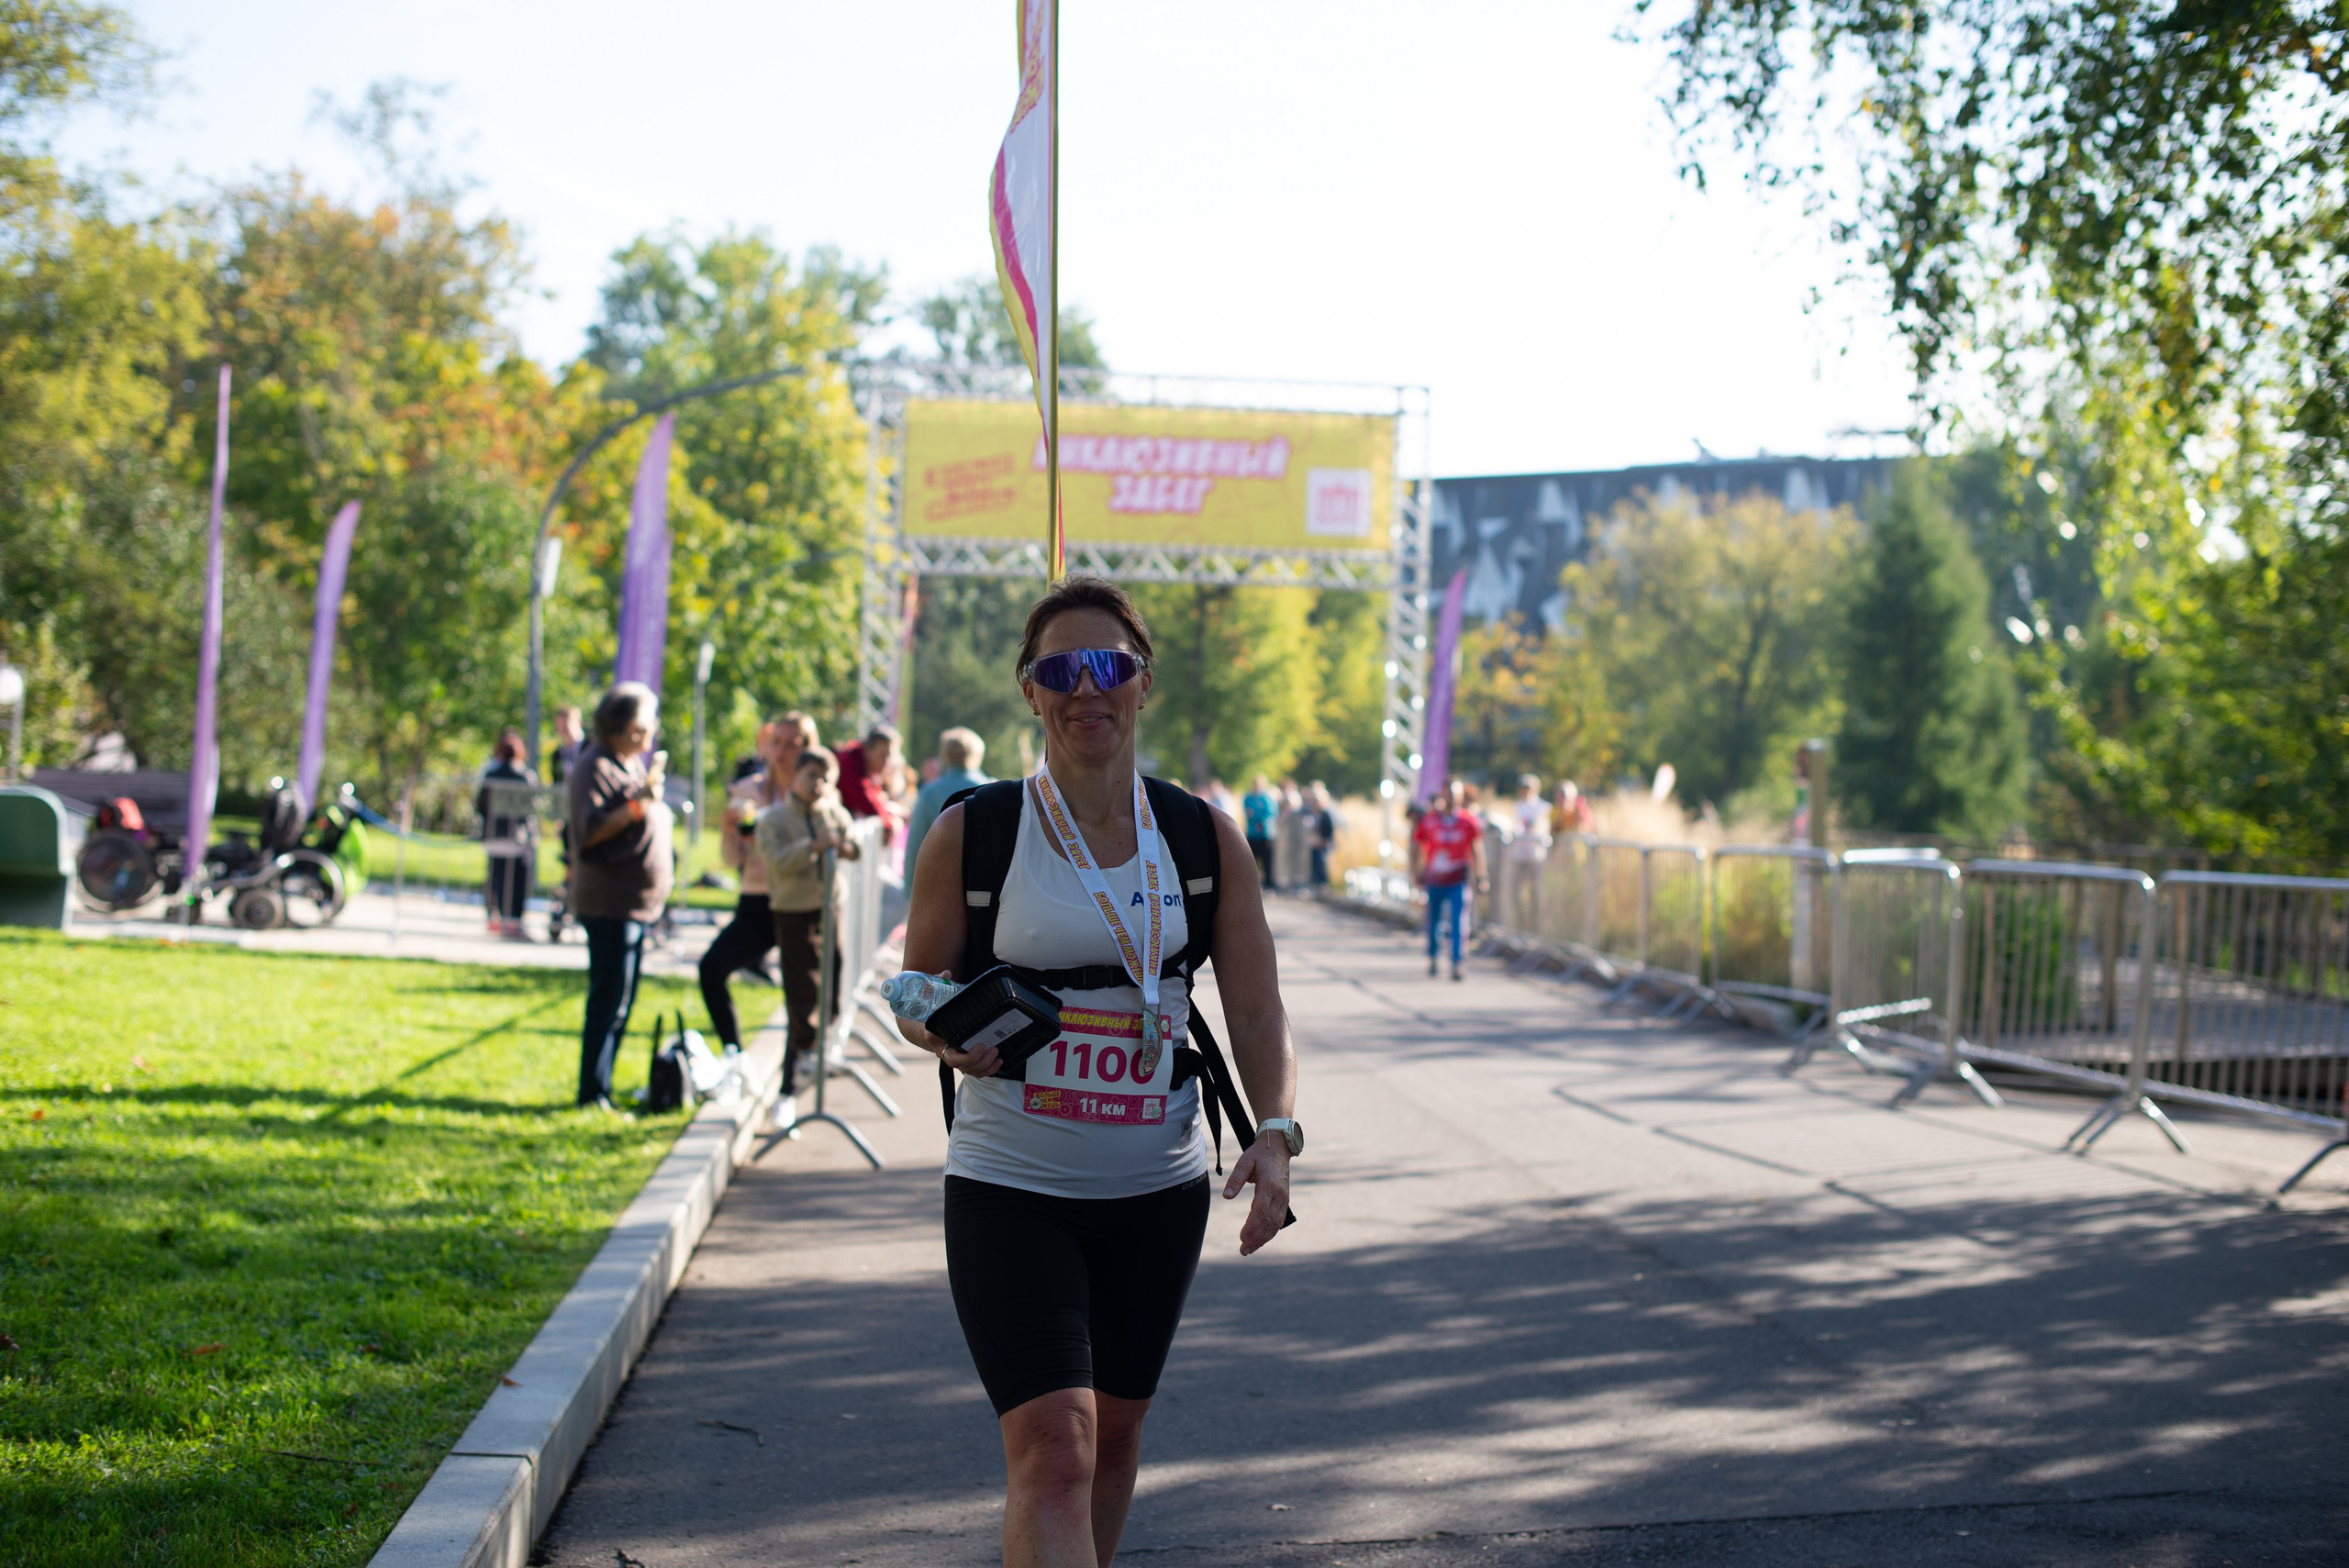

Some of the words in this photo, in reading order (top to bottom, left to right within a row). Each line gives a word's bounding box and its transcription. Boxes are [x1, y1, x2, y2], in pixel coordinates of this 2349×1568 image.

[1038, 774, 1076, 841] ИНКЛЮЗИВНЫЙ
[1066, 841, 1092, 871] ЗАБЕГ
[1145, 860, 1159, 892] ЗАБЕГ
[1093, 891, 1123, 928] БОЛЬШЕ
[1113, 924, 1132, 946] ЧЕМ
[1147, 892, 1162, 976] ИНКЛЮЗИВНЫЙ
[1059, 1011, 1130, 1029] НКЛЮЗИВНЫЙ
[1080, 1097, 1097, 1114] 11
